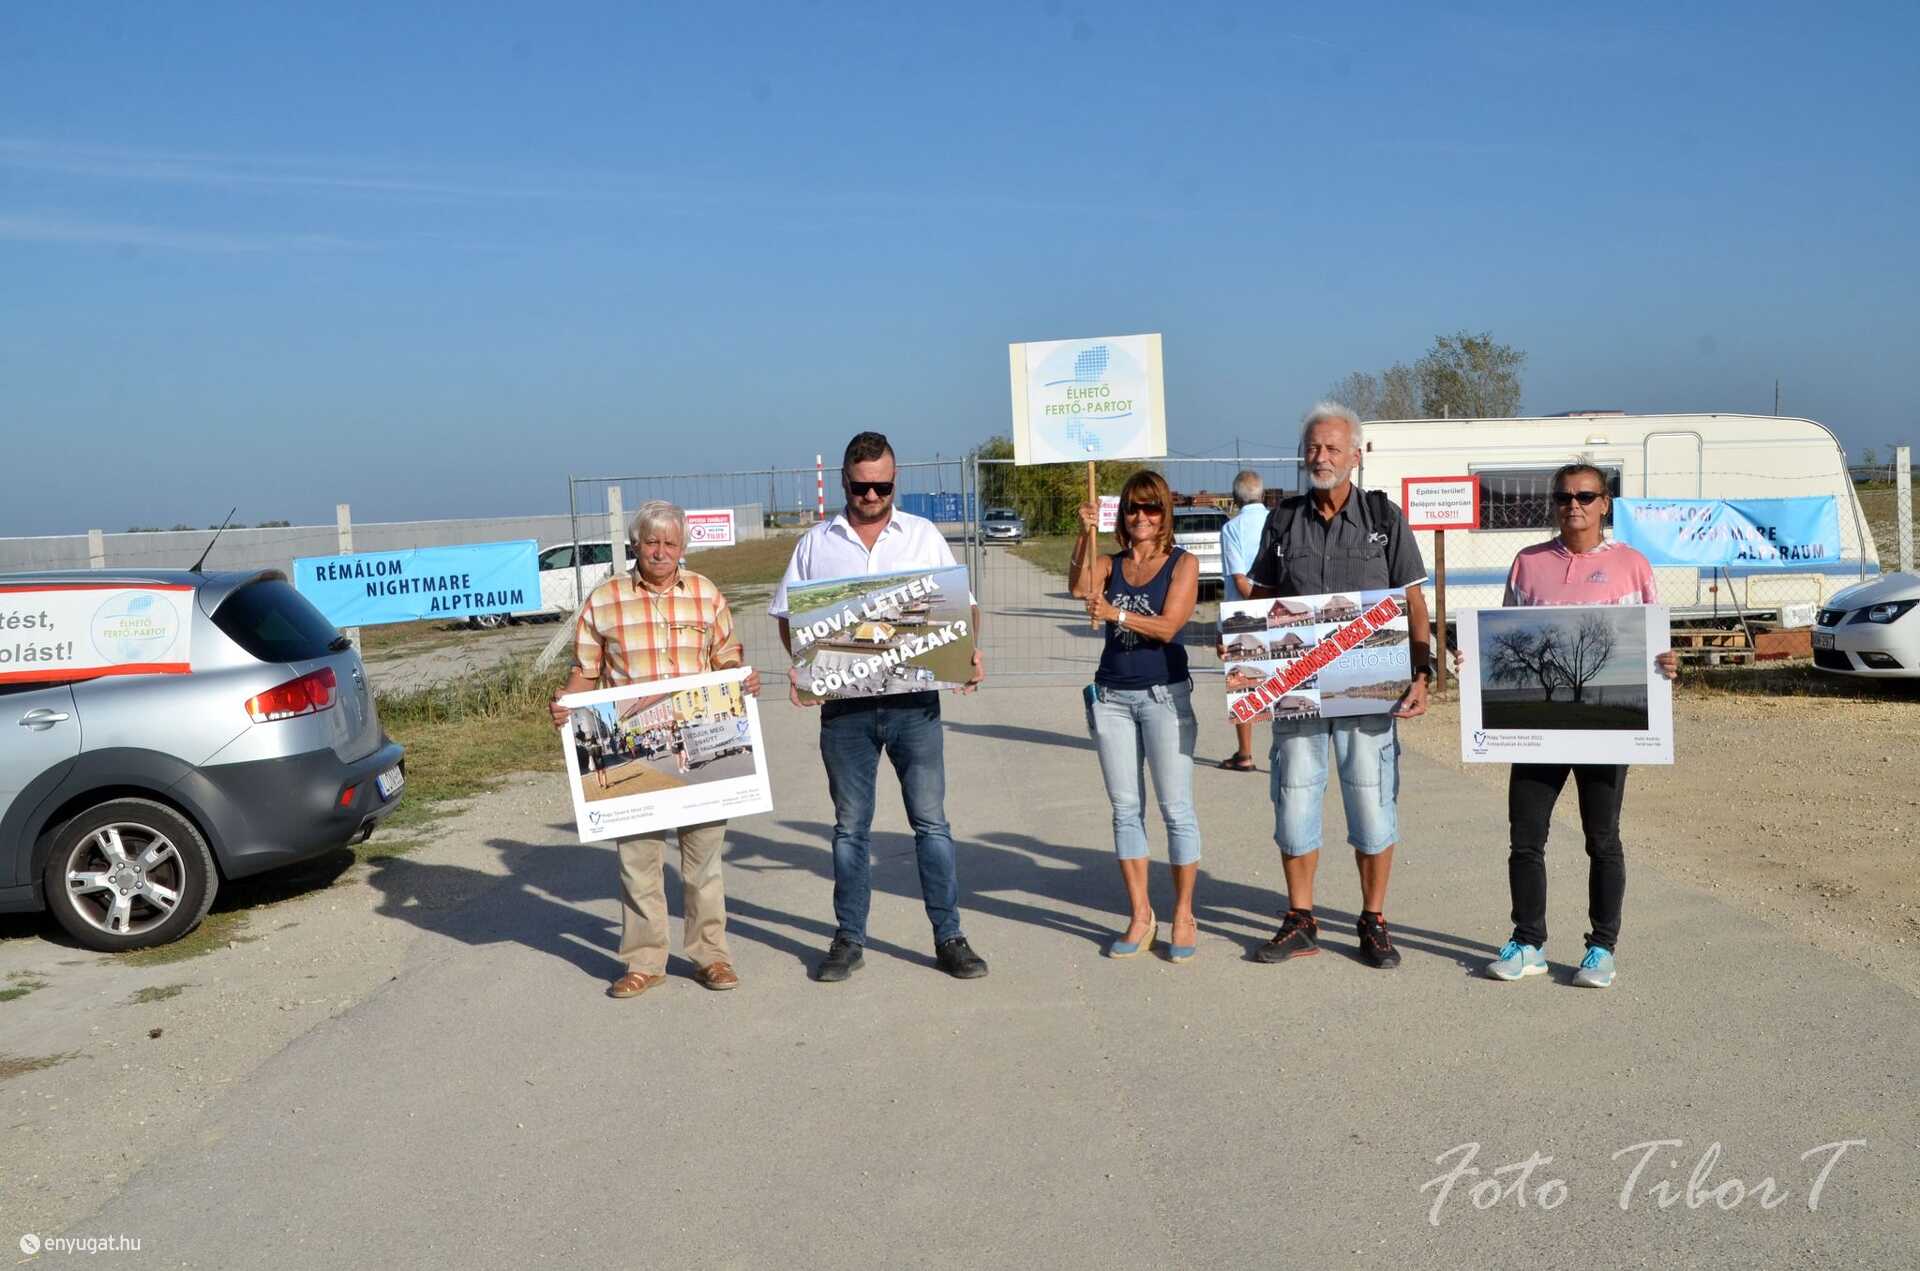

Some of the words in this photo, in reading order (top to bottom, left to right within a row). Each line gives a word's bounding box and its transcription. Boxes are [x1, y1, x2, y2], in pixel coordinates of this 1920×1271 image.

[1067, 384, 1110, 399] ÉLHETŐ
[1045, 400, 1133, 416] FERTŐ-PARTOT
[316, 559, 402, 581] RÉMÁLOM
[366, 573, 470, 597] NIGHTMARE
[430, 589, 524, 612] ALPTRAUM
[796, 605, 859, 645] HOVÁ
[861, 574, 940, 617] LETTEK
[872, 627, 888, 644] A
[811, 620, 968, 696] CÖLÖPHÁZAK?
